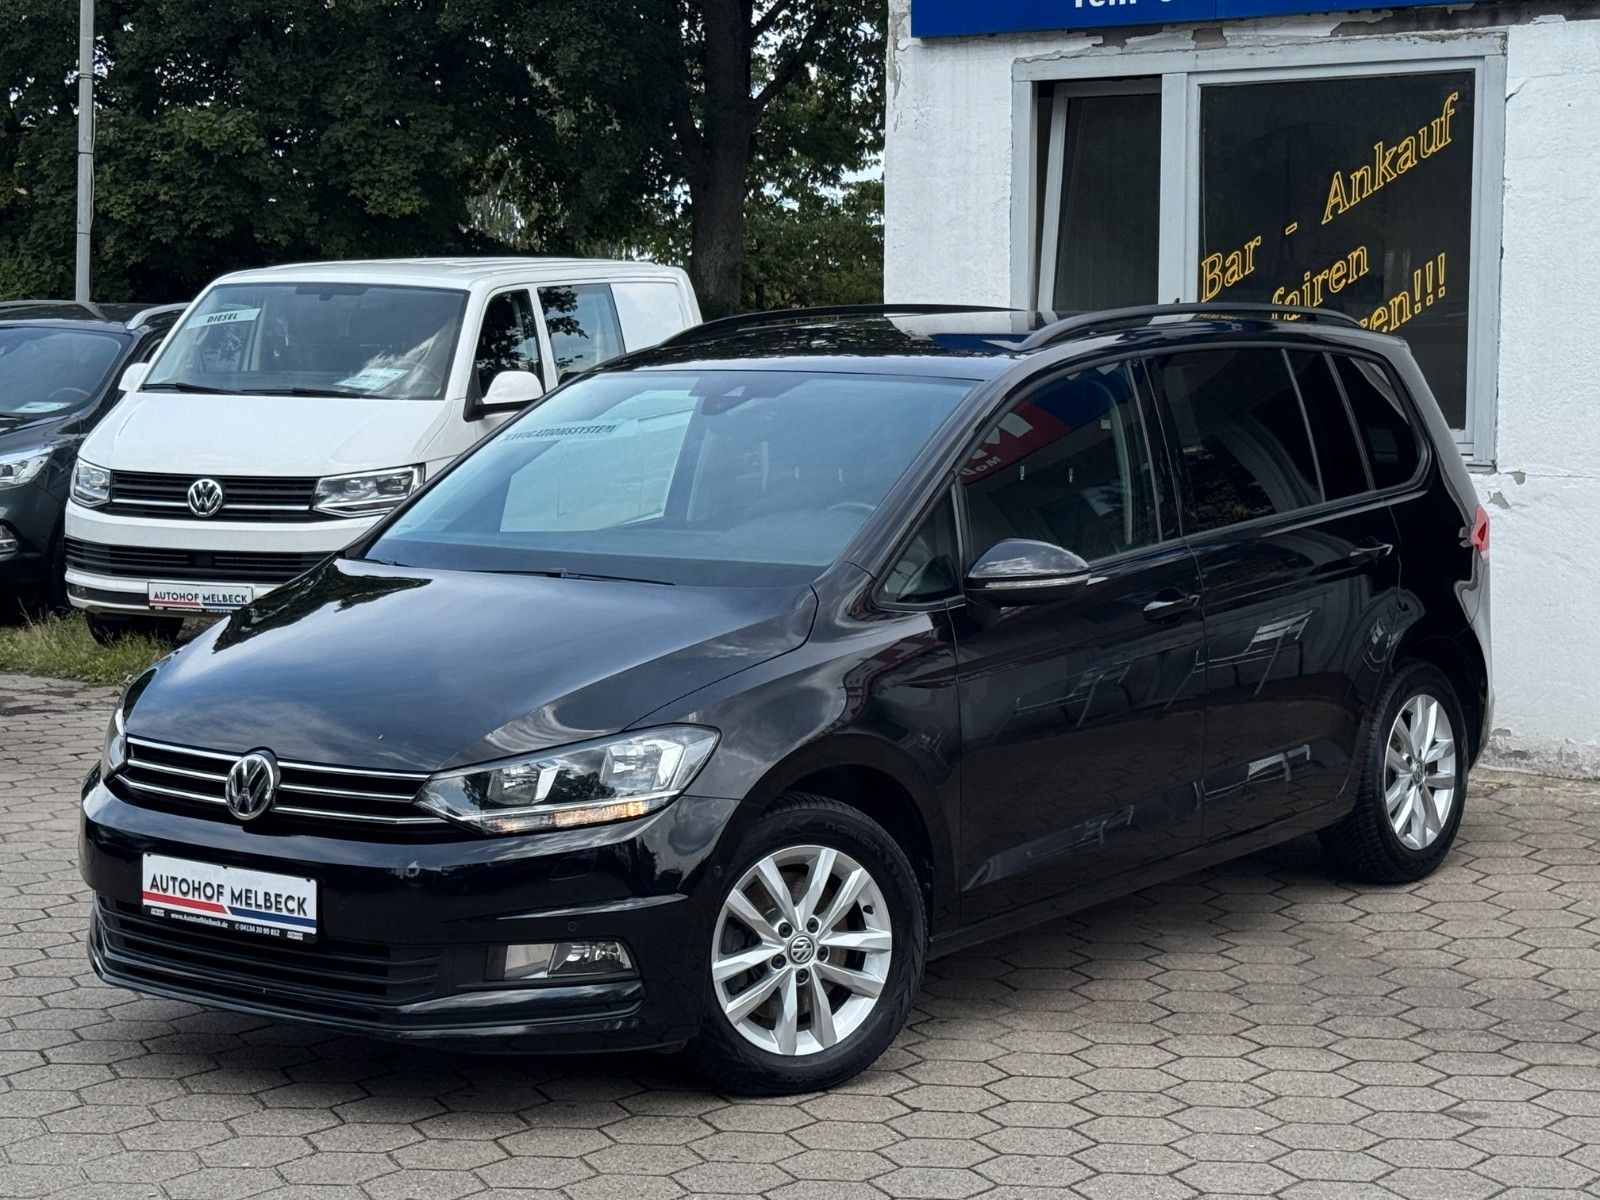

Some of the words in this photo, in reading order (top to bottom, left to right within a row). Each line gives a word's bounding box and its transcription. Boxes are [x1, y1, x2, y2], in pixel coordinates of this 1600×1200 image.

[1201, 235, 1262, 303] Bar
[1321, 91, 1459, 225] Ankauf
[207, 312, 238, 323] DIESEL
[187, 478, 224, 518] VW
[153, 591, 199, 602] AUTOHOF
[202, 593, 248, 604] MELBECK
[225, 752, 276, 821] VW
[149, 873, 225, 903] AUTOHOF
[230, 886, 308, 917] MELBECK
